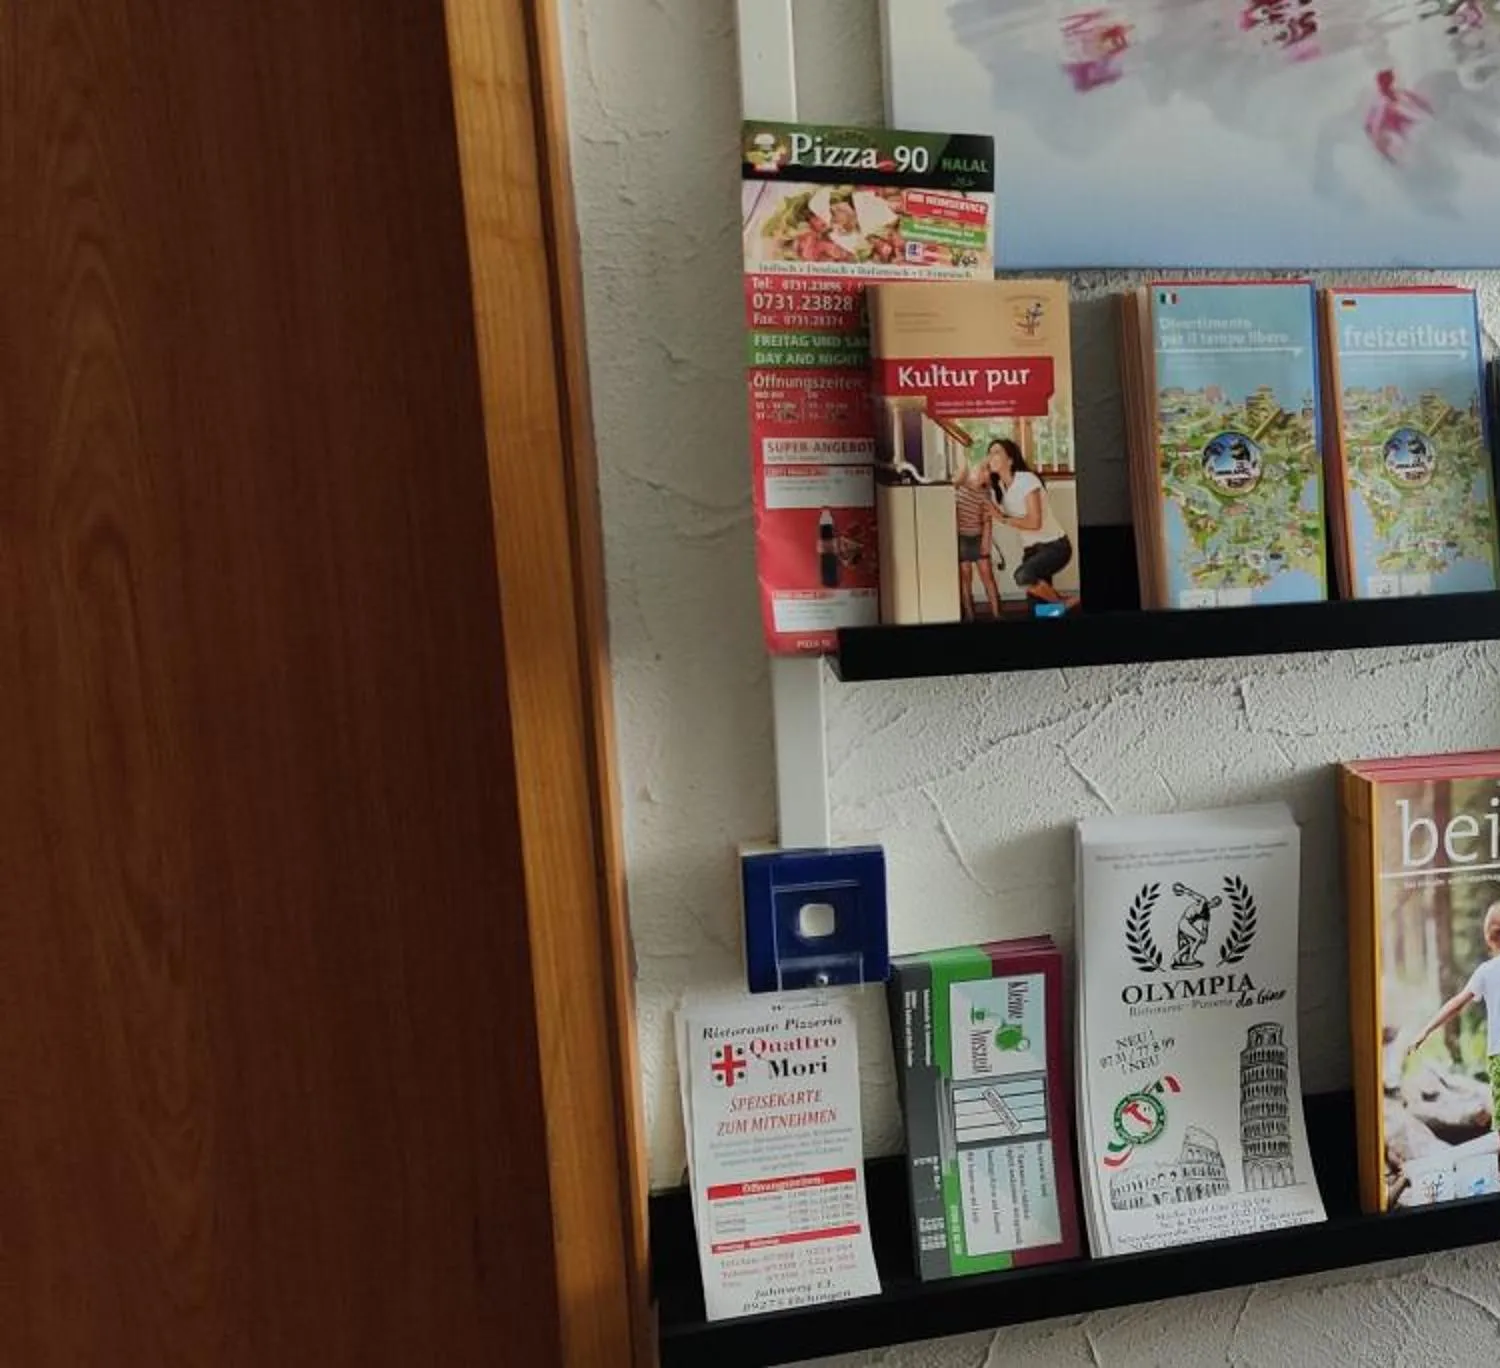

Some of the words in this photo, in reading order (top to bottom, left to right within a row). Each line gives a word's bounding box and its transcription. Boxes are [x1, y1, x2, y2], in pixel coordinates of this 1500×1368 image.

[788, 132, 879, 170] Pizza
[894, 145, 929, 173] 90
[941, 158, 989, 174] HALAL
[1159, 316, 1252, 330] Divertimento
[1343, 322, 1470, 349] freizeitlust
[754, 334, 810, 348] FREITAG
[812, 336, 842, 348] UND
[754, 352, 784, 365] DAY
[785, 352, 815, 365] AND
[897, 364, 979, 388] Kultur
[985, 367, 1031, 393] pur
[1007, 981, 1030, 1020] Kleine
[1121, 972, 1257, 1005] OLYMPIA
[703, 1022, 778, 1040] Ristorante
[785, 1015, 842, 1031] Pizzeria
[750, 1035, 837, 1059] Quattro
[768, 1055, 828, 1079] Mori
[729, 1088, 824, 1113] SPEISEKARTE
[716, 1118, 749, 1137] ZUM
[751, 1107, 838, 1133] MITNEHMEN
